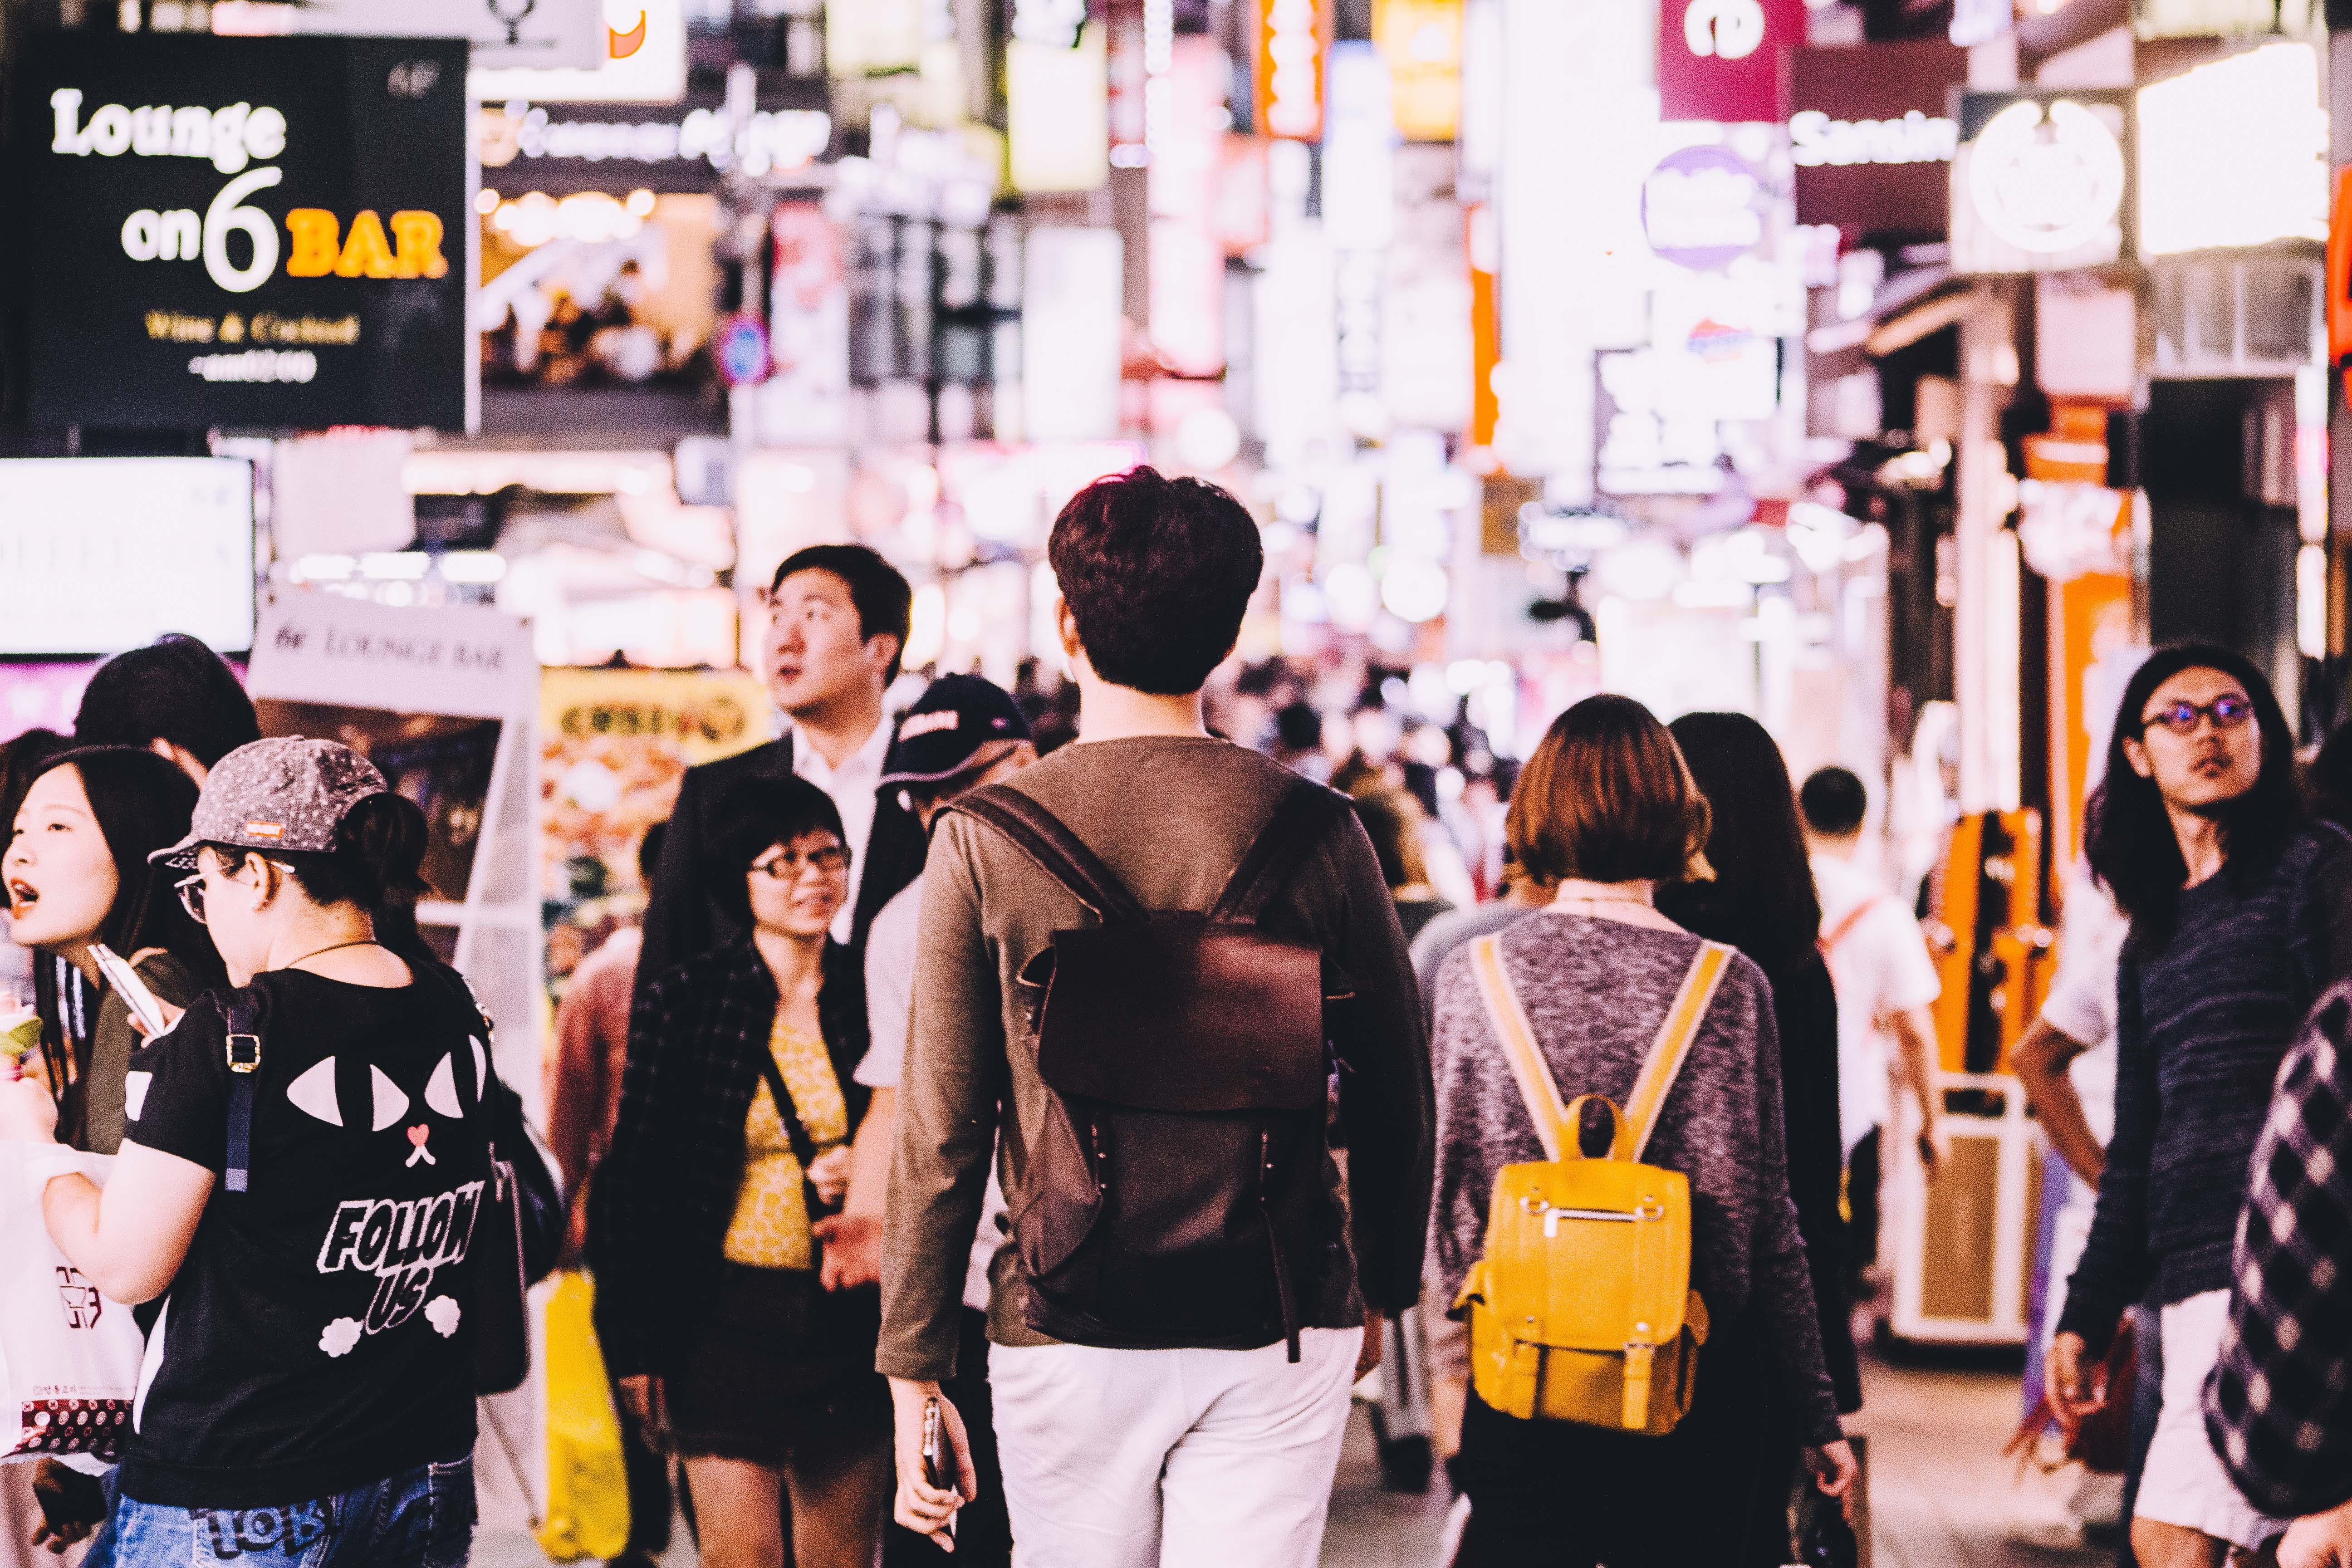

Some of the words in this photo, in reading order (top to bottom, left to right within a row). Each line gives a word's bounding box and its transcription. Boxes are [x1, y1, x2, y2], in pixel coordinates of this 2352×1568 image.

[50, 88, 287, 174] Lounge
[285, 208, 449, 279] BAR
[316, 1181, 485, 1274] FOLLOW
[365, 1266, 435, 1335] US
